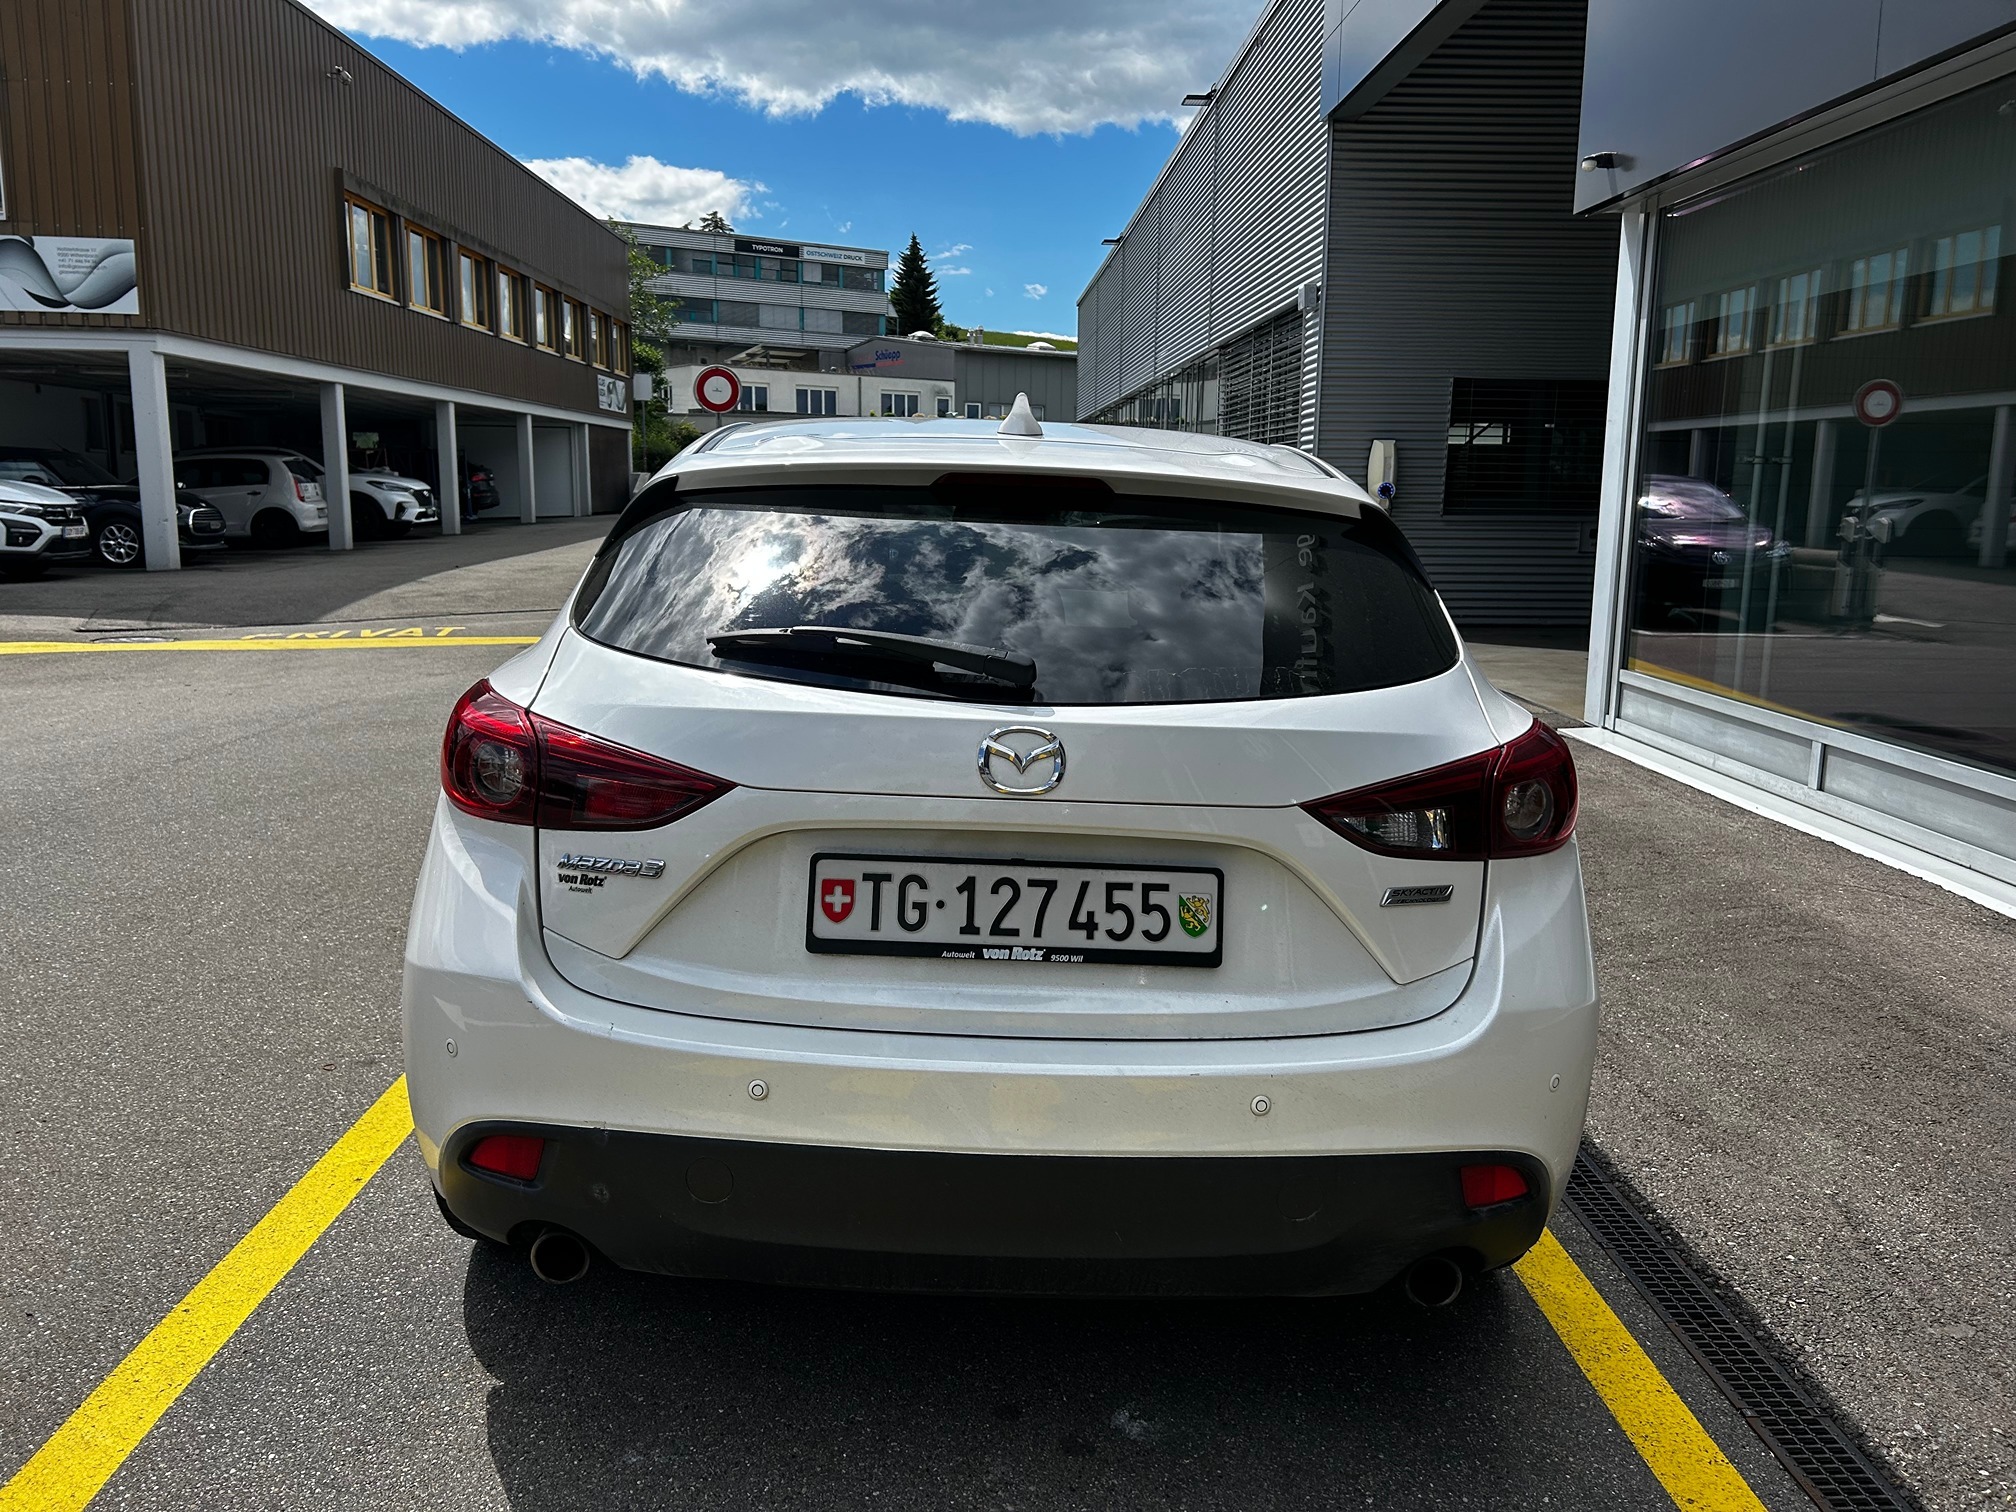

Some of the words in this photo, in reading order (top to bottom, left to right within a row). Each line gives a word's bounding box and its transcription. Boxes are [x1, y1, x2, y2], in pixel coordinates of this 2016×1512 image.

[752, 244, 784, 253] TYPOTRON
[806, 250, 842, 260] OSTSCHWEIZ
[843, 254, 863, 262] DRUCK
[558, 873, 578, 884] von
[568, 885, 593, 894] Autowelt
[1391, 888, 1447, 897] SKYACTIV
[941, 950, 976, 959] Autowelt
[983, 948, 1009, 960] von
[1050, 954, 1069, 962] 9500
[1070, 955, 1084, 963] Wil
